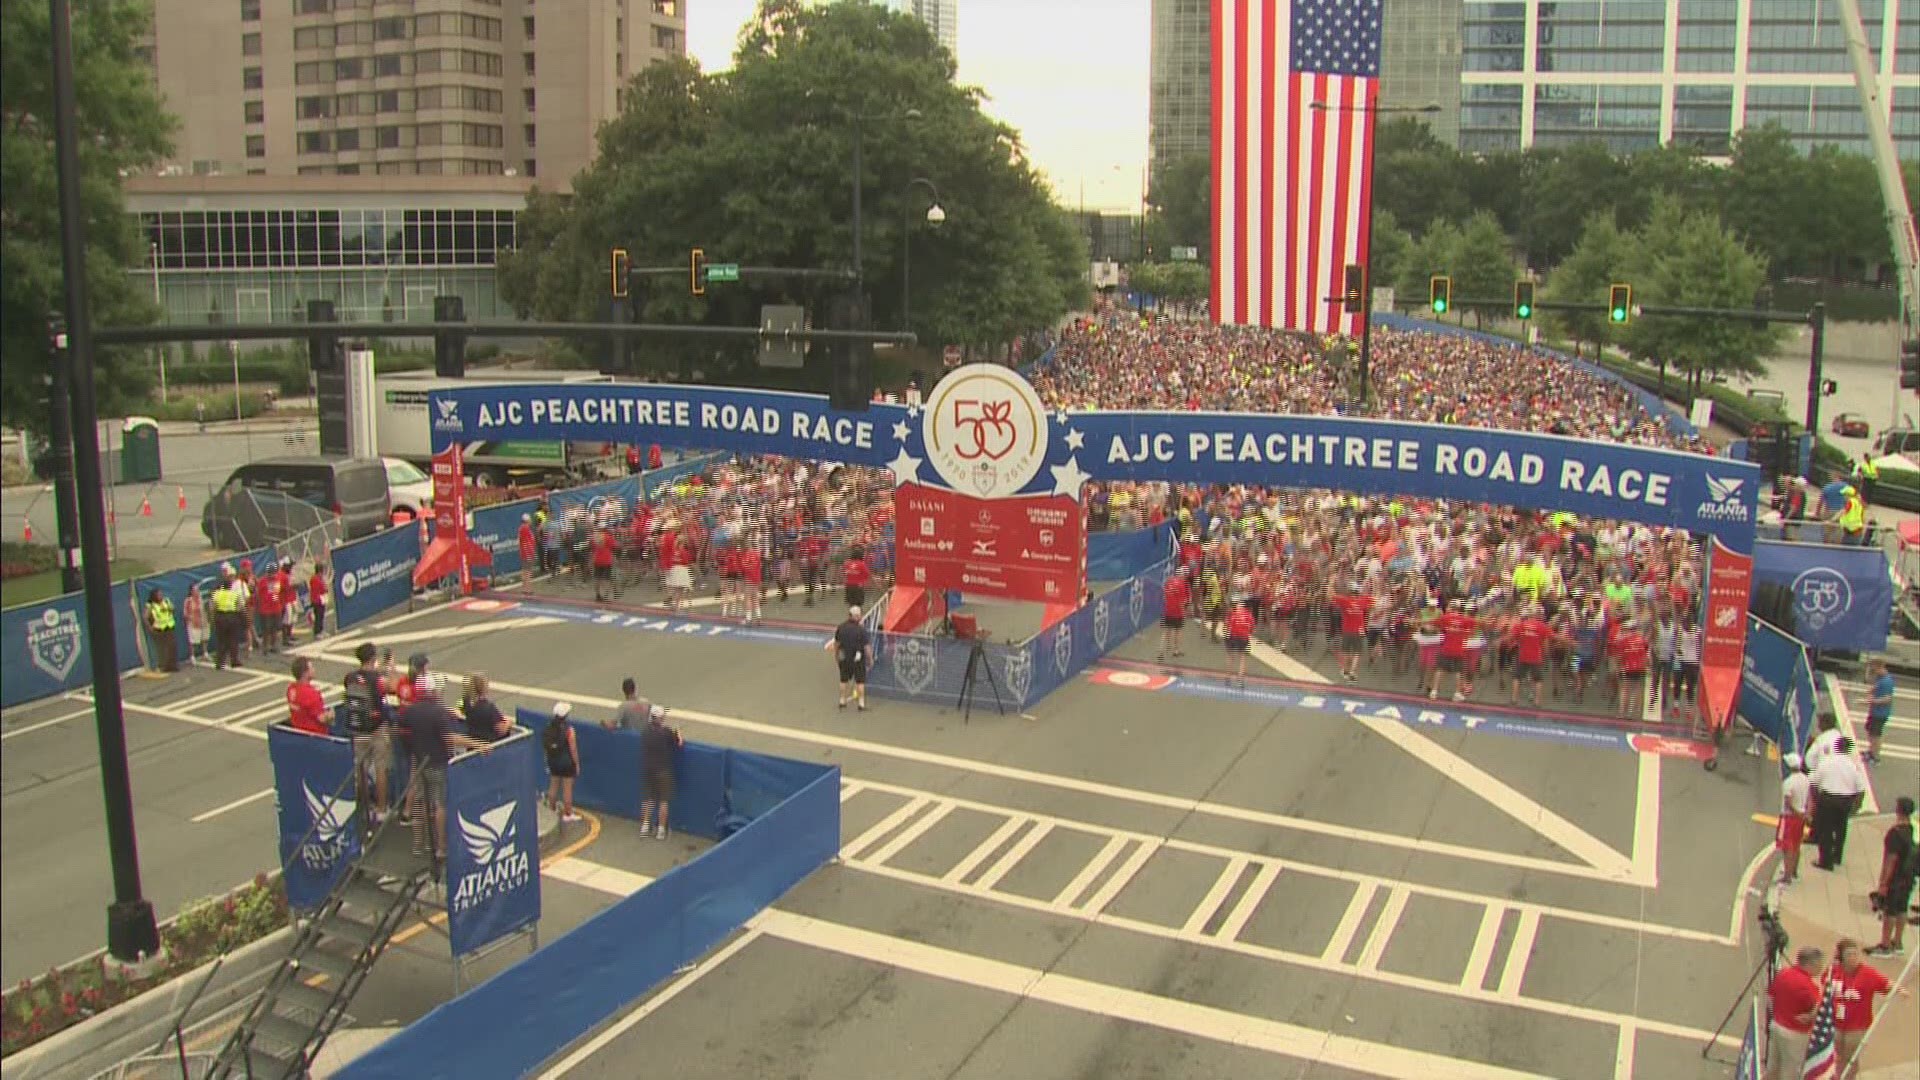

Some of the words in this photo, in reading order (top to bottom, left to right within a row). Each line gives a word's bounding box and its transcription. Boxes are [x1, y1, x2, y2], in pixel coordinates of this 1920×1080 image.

[478, 401, 523, 428] AJC
[531, 398, 690, 426] PEACHTREE
[701, 402, 780, 435] ROAD
[792, 411, 874, 449] RACE
[954, 400, 1017, 461] 50
[1107, 433, 1175, 464] AJC
[1188, 432, 1420, 471] PEACHTREE
[1434, 444, 1544, 485] ROAD
[1559, 459, 1671, 506] RACE
[1697, 502, 1748, 515] ATLANTA
[1801, 579, 1839, 612] 50
[592, 609, 731, 636] START
[1299, 696, 1486, 729] START
[454, 851, 529, 901] ATLANTA
[454, 889, 494, 913] TRACK
[498, 873, 529, 893] CLUB
